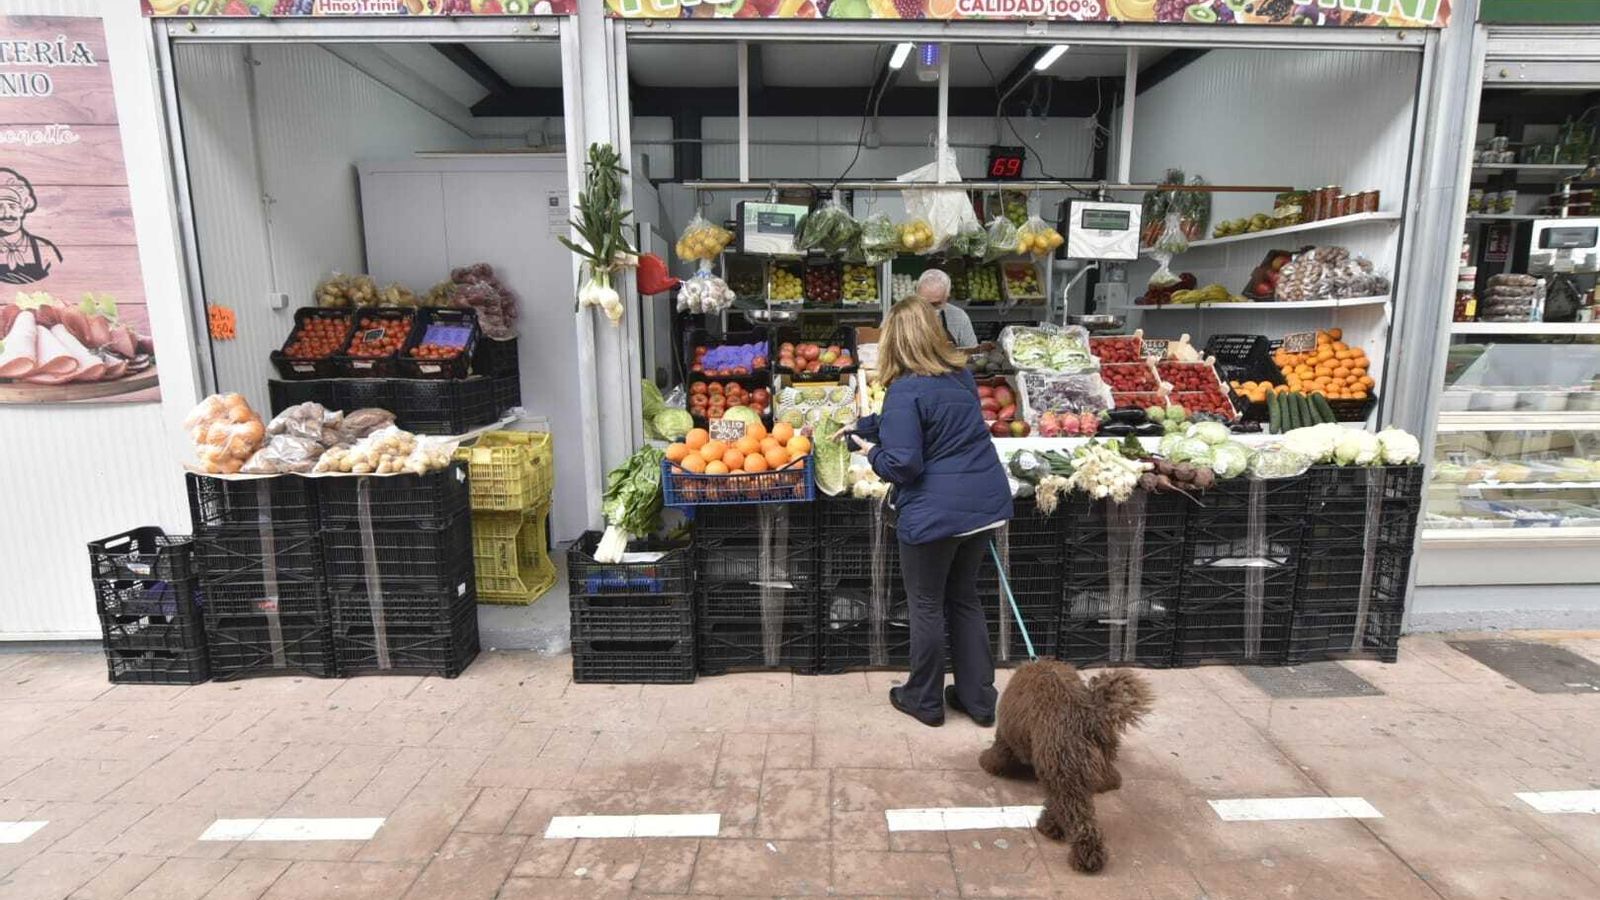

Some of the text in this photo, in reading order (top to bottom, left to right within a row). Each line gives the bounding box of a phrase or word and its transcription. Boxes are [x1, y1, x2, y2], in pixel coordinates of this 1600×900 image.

[958, 0, 1097, 13] CALIDAD 100%
[992, 158, 1020, 176] 69
